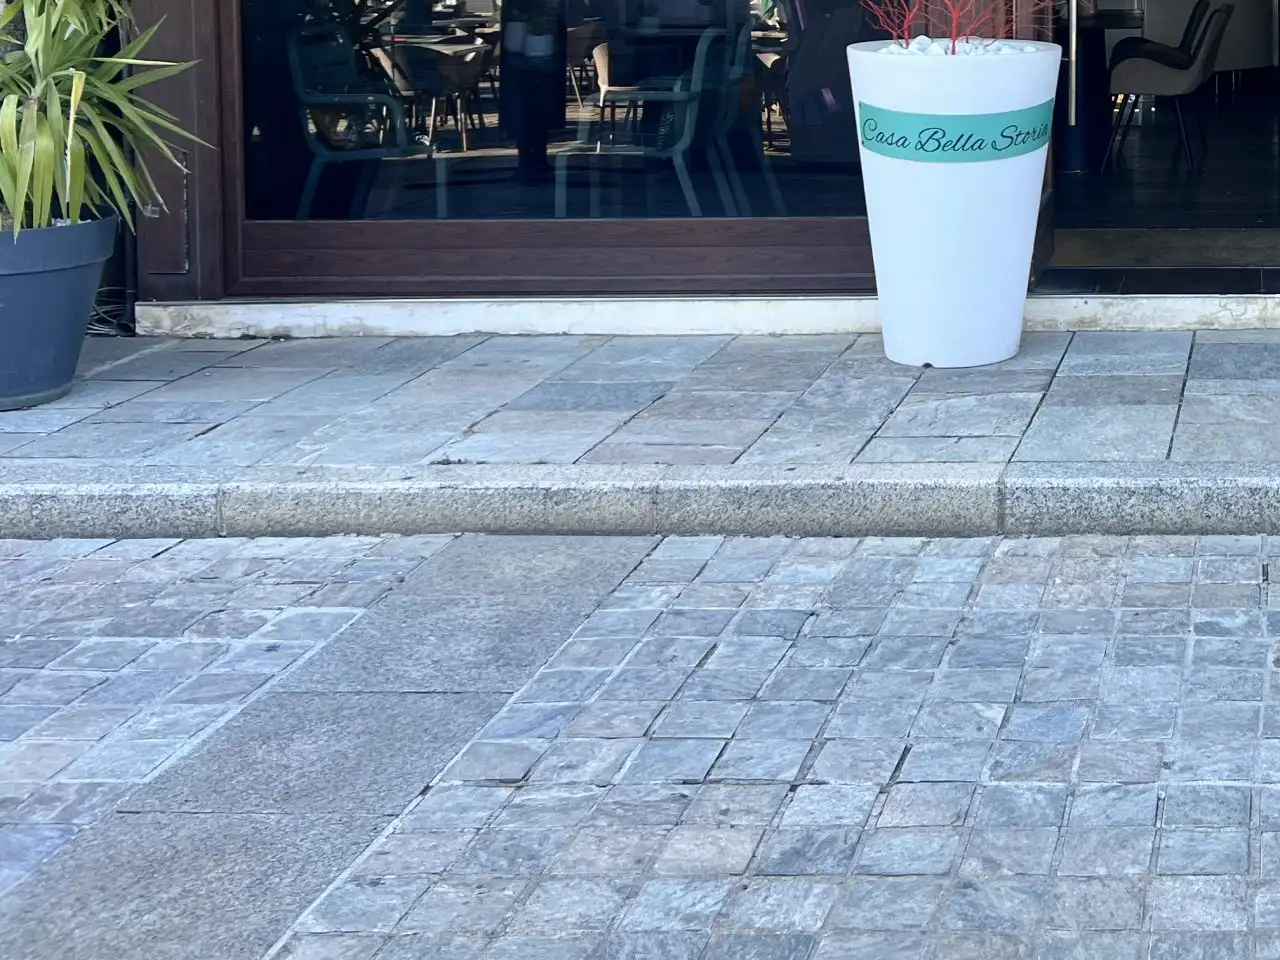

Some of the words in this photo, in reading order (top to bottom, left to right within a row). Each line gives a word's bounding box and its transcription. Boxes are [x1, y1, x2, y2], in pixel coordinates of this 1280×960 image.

[863, 118, 911, 149] Casa
[915, 127, 988, 153] Bella
[991, 123, 1049, 151] Storia
